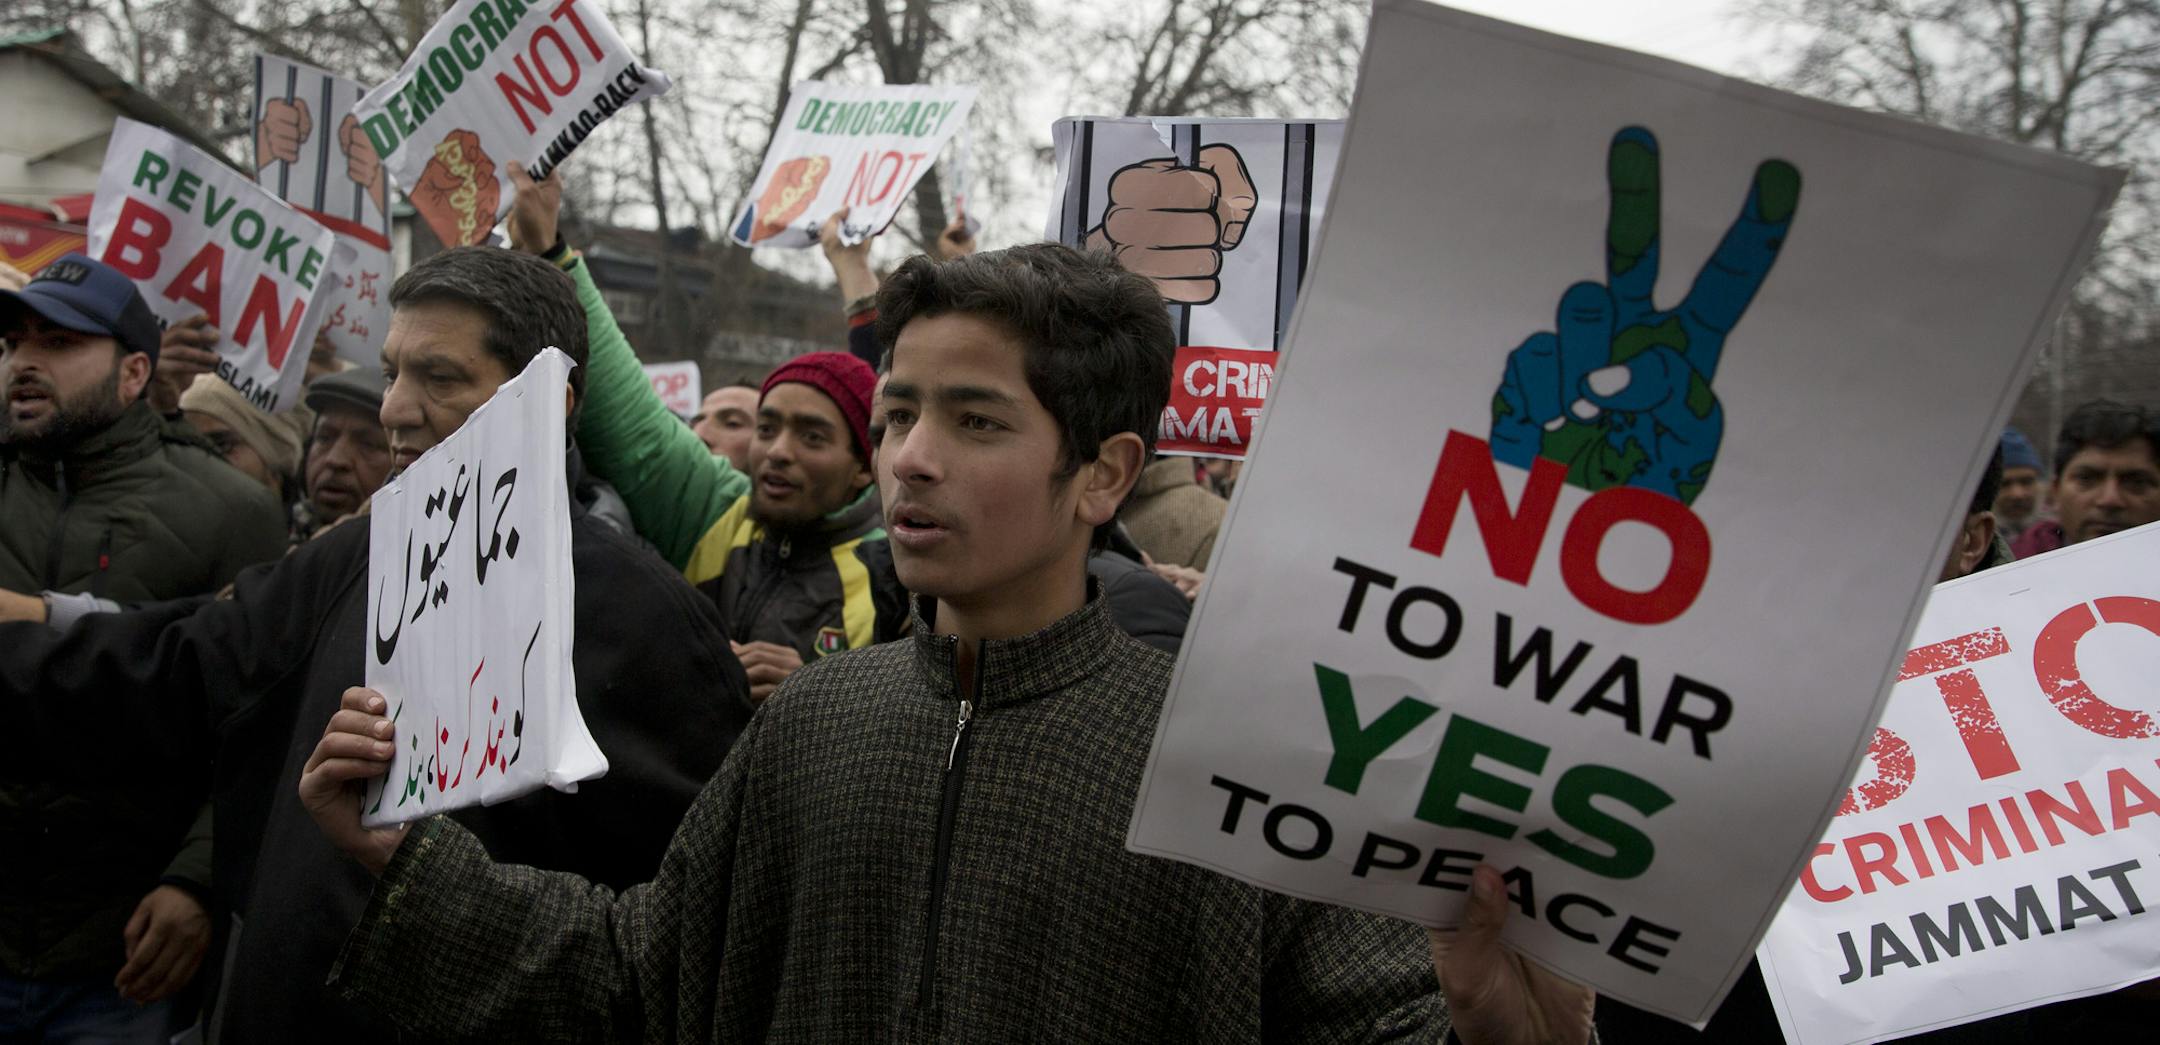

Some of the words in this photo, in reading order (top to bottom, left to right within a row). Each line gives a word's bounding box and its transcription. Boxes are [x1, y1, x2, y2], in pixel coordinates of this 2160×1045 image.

[361, 0, 541, 160] DEMOCRA
[495, 0, 604, 135] NOT
[797, 98, 957, 137] DEMOCRACY
[133, 150, 324, 292] REVOKE
[842, 150, 928, 207] NOT
[102, 197, 306, 372] BAN
[1410, 429, 1711, 625] NO
[509, 620, 542, 767] کو
[1333, 557, 1462, 660] TO
[1493, 612, 1733, 761] WAR
[397, 733, 425, 805] بند
[476, 695, 507, 780] بند
[1313, 662, 1675, 880] YES
[1210, 775, 1333, 861] TO
[1352, 832, 1681, 976] PEACE
[1800, 759, 2160, 903] CRIMINA
[1837, 859, 2147, 985] JAMMAT
